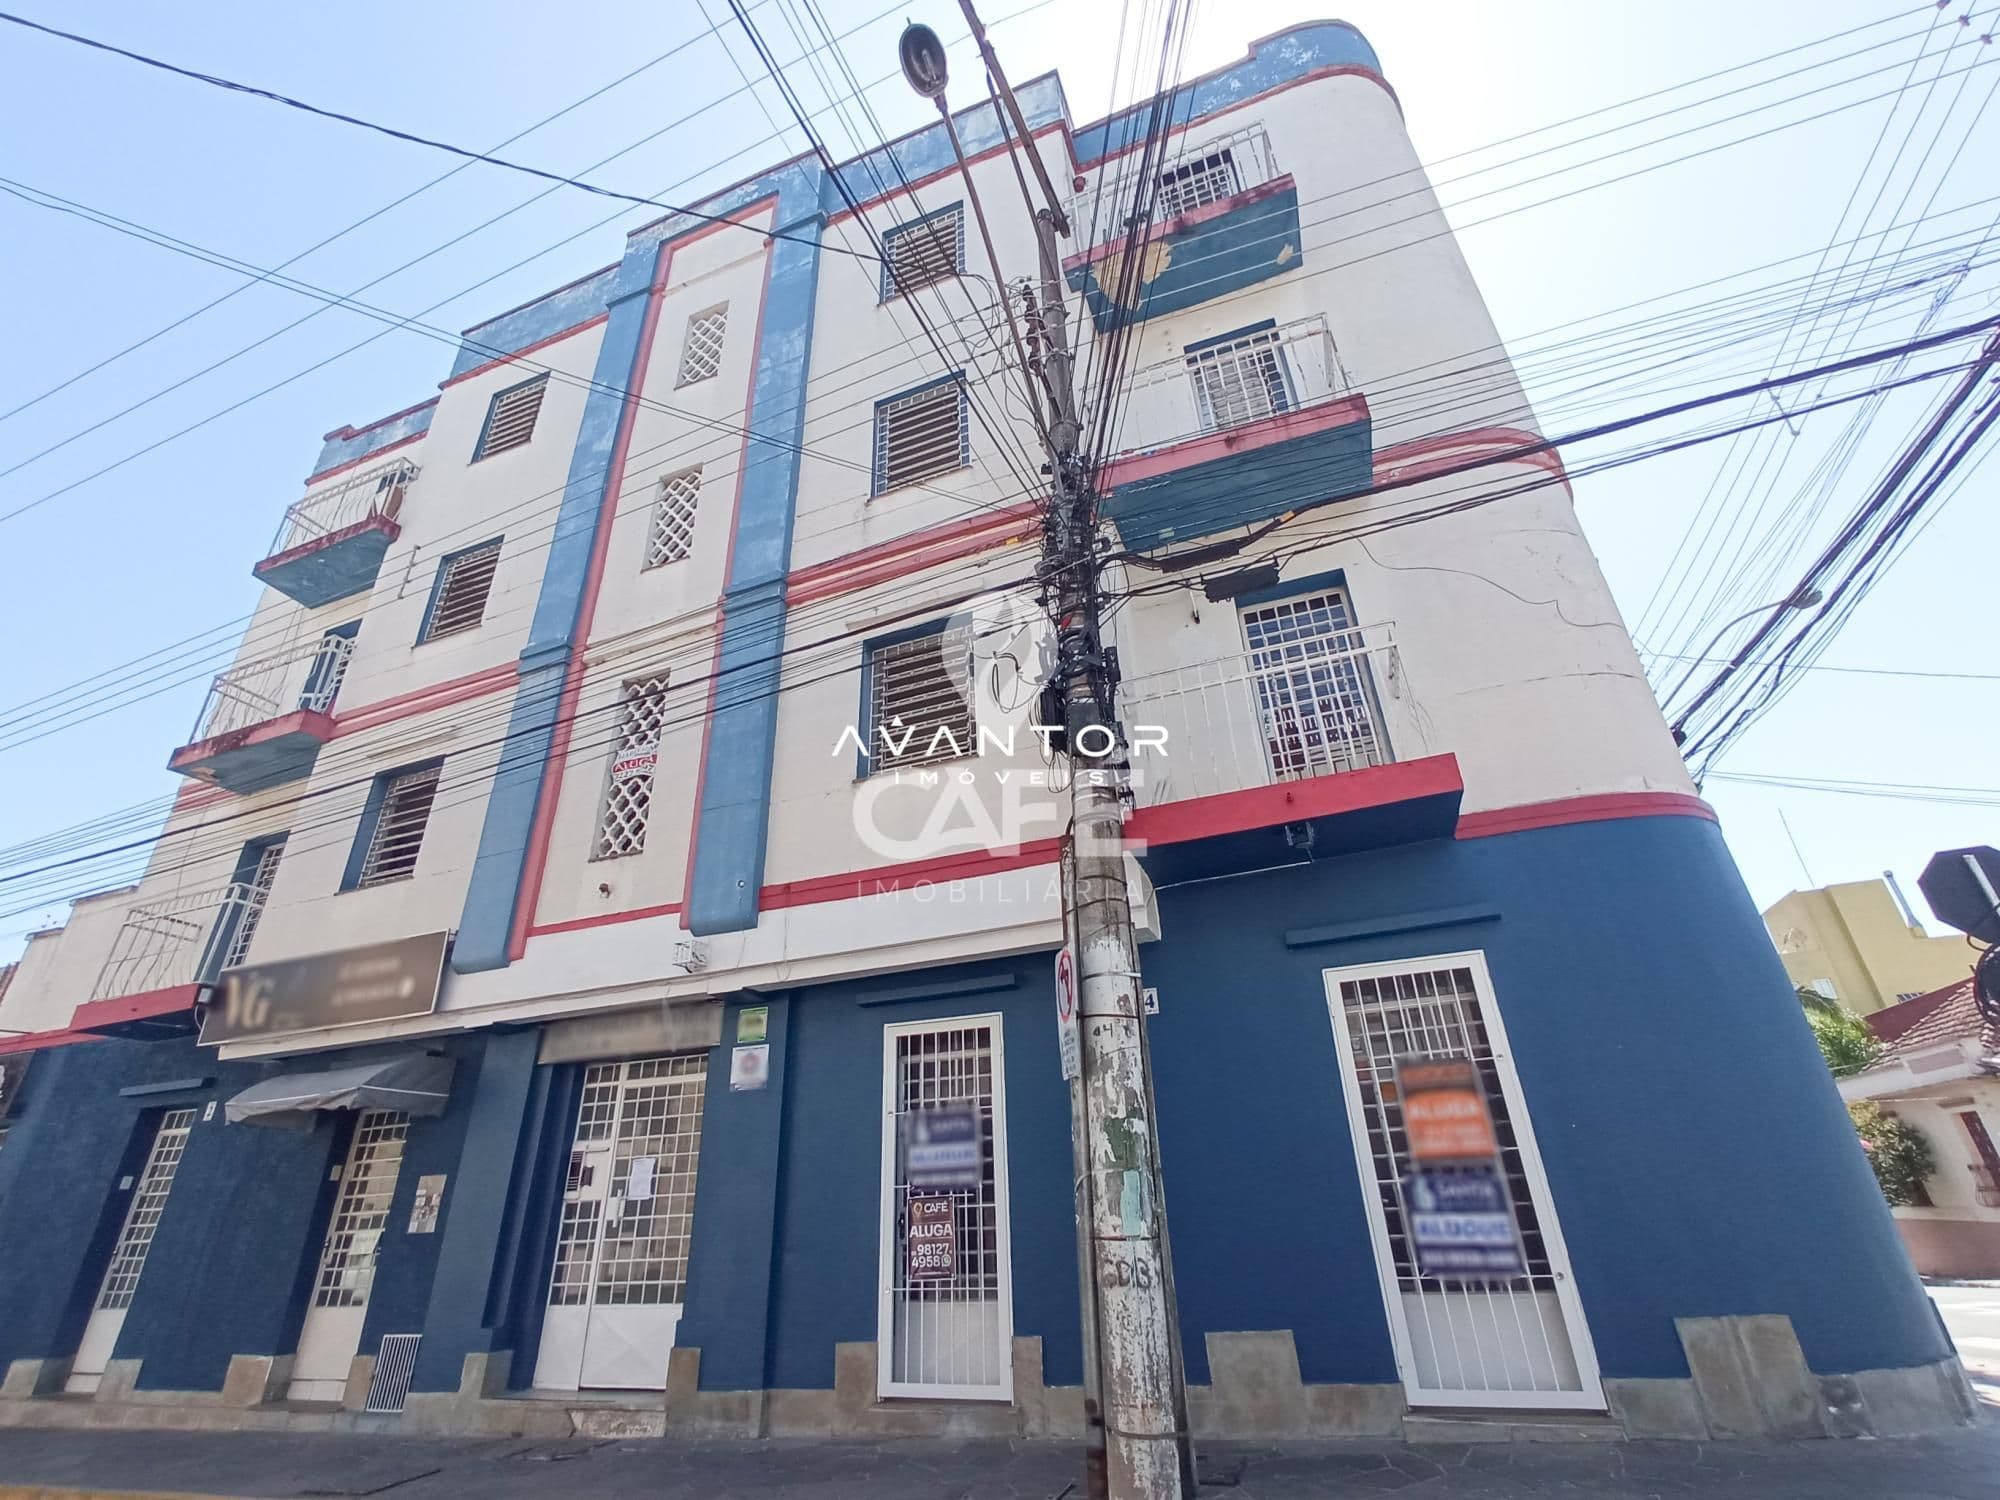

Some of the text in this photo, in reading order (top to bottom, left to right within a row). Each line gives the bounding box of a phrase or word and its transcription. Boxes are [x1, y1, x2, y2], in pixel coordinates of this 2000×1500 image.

[923, 1199, 948, 1213] CAFÉ
[909, 1223, 953, 1238] ALUGA
[916, 1243, 949, 1256] 98127
[911, 1255, 941, 1268] 4958
